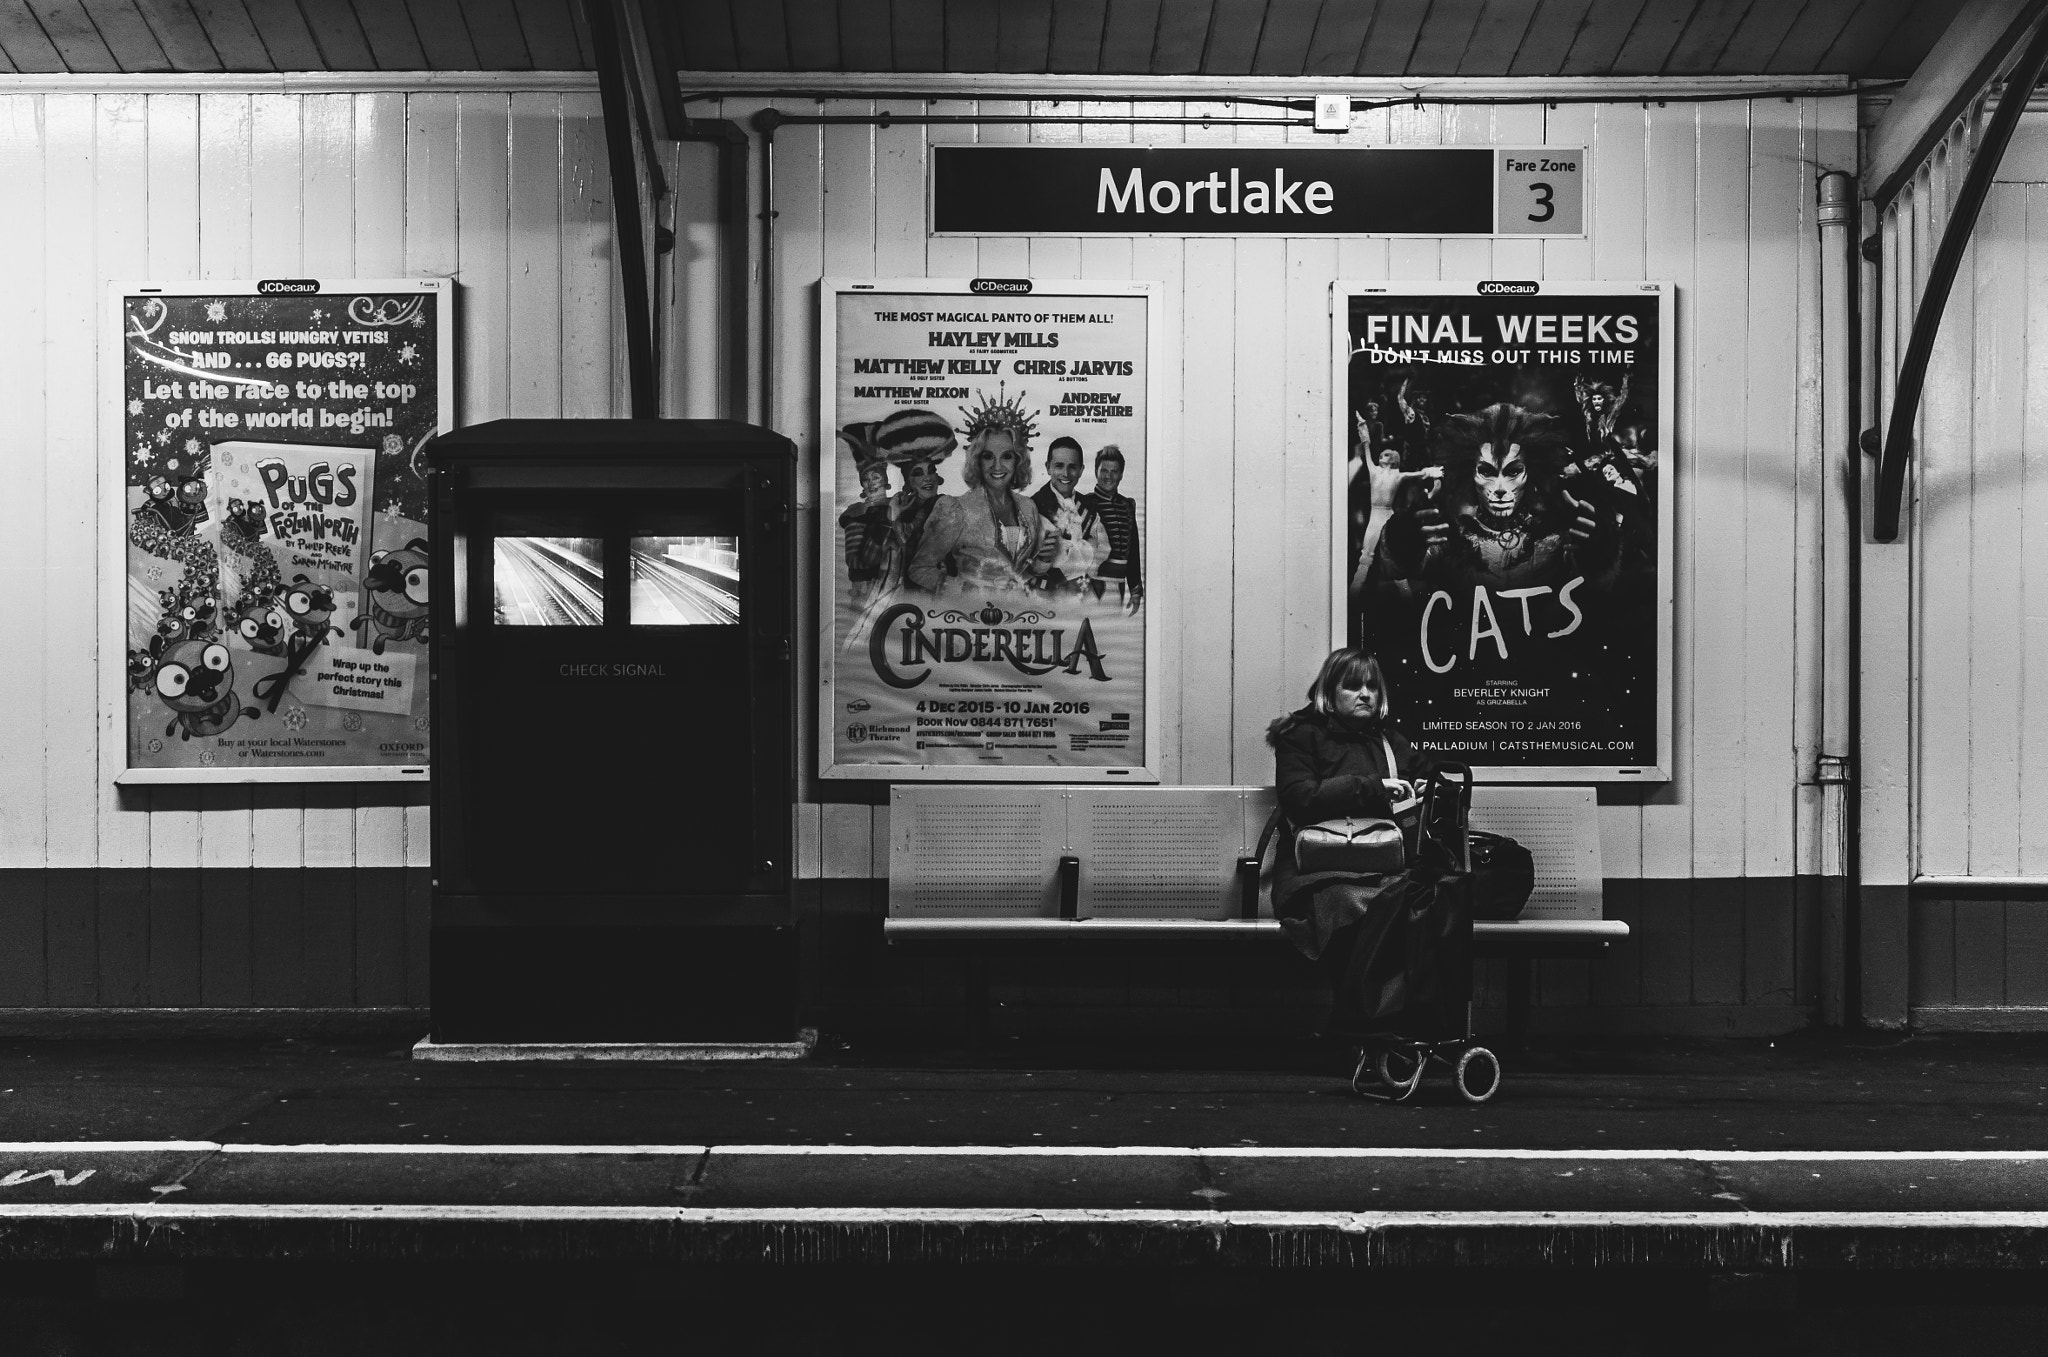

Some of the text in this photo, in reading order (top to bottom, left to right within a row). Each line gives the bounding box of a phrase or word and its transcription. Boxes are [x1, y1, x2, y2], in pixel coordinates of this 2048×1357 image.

[1506, 159, 1576, 172] Fare Zone
[1096, 167, 1335, 215] Mortlake
[1527, 182, 1555, 222] 3
[261, 282, 316, 292] JCDecaux
[973, 281, 1029, 292] JCDecaux
[1481, 284, 1536, 294] JCDecaux
[874, 312, 1114, 324] THE MOST MAGICAL PANTO OF THEM ALL!
[1367, 315, 1639, 344] FINAL WEEKS
[169, 331, 388, 345] SNOW TROLLS! HUNGRY YETIS!
[928, 331, 1059, 348] HAYLEY MILLS
[192, 352, 231, 368] AND
[266, 352, 292, 368] 66
[297, 352, 366, 368] PUGS?!
[1370, 350, 1635, 364] DON'T MISS OUT THIS TIME
[854, 358, 1001, 375] MATTHEW KELLY
[1013, 360, 1133, 376] CHRIS JARVIS
[144, 380, 416, 404] Let the race to the top
[854, 386, 970, 399] MATTHEW RIXON
[1061, 392, 1121, 404] ANDREW
[1049, 404, 1133, 417] DERBYSHIRE
[165, 407, 393, 434] of the world begin!
[281, 501, 324, 512] OF THE
[269, 512, 359, 545] FROZEN NORTH
[325, 542, 351, 556] REEVE
[292, 555, 317, 568] SARAH
[1420, 576, 1585, 674] CATS
[332, 658, 390, 673] Wrap up the
[560, 664, 666, 676] CHECK SIGNAL
[317, 671, 402, 688] perfect story this
[332, 685, 384, 699] Christmas!
[1453, 688, 1550, 697] BEVERLEY KNIGHT
[916, 701, 926, 713] 4
[958, 701, 995, 713] 2015
[1003, 701, 1021, 713] 10
[1052, 702, 1090, 714] 2016
[970, 717, 1001, 727] 0844
[1004, 718, 1024, 727] 871
[1422, 721, 1581, 730] LIMITED SEASON TO 2 JAN 2016
[218, 738, 235, 748] Buy
[248, 740, 268, 748] your
[270, 738, 291, 746] local
[293, 738, 346, 746] Waterstones
[869, 733, 901, 741] Theatre
[380, 743, 424, 751] OXFORD
[1422, 741, 1487, 750] PALLADIUM
[1499, 741, 1634, 750] CATSTHEMUSICAL.COM
[251, 749, 325, 757] Waterstones.com
